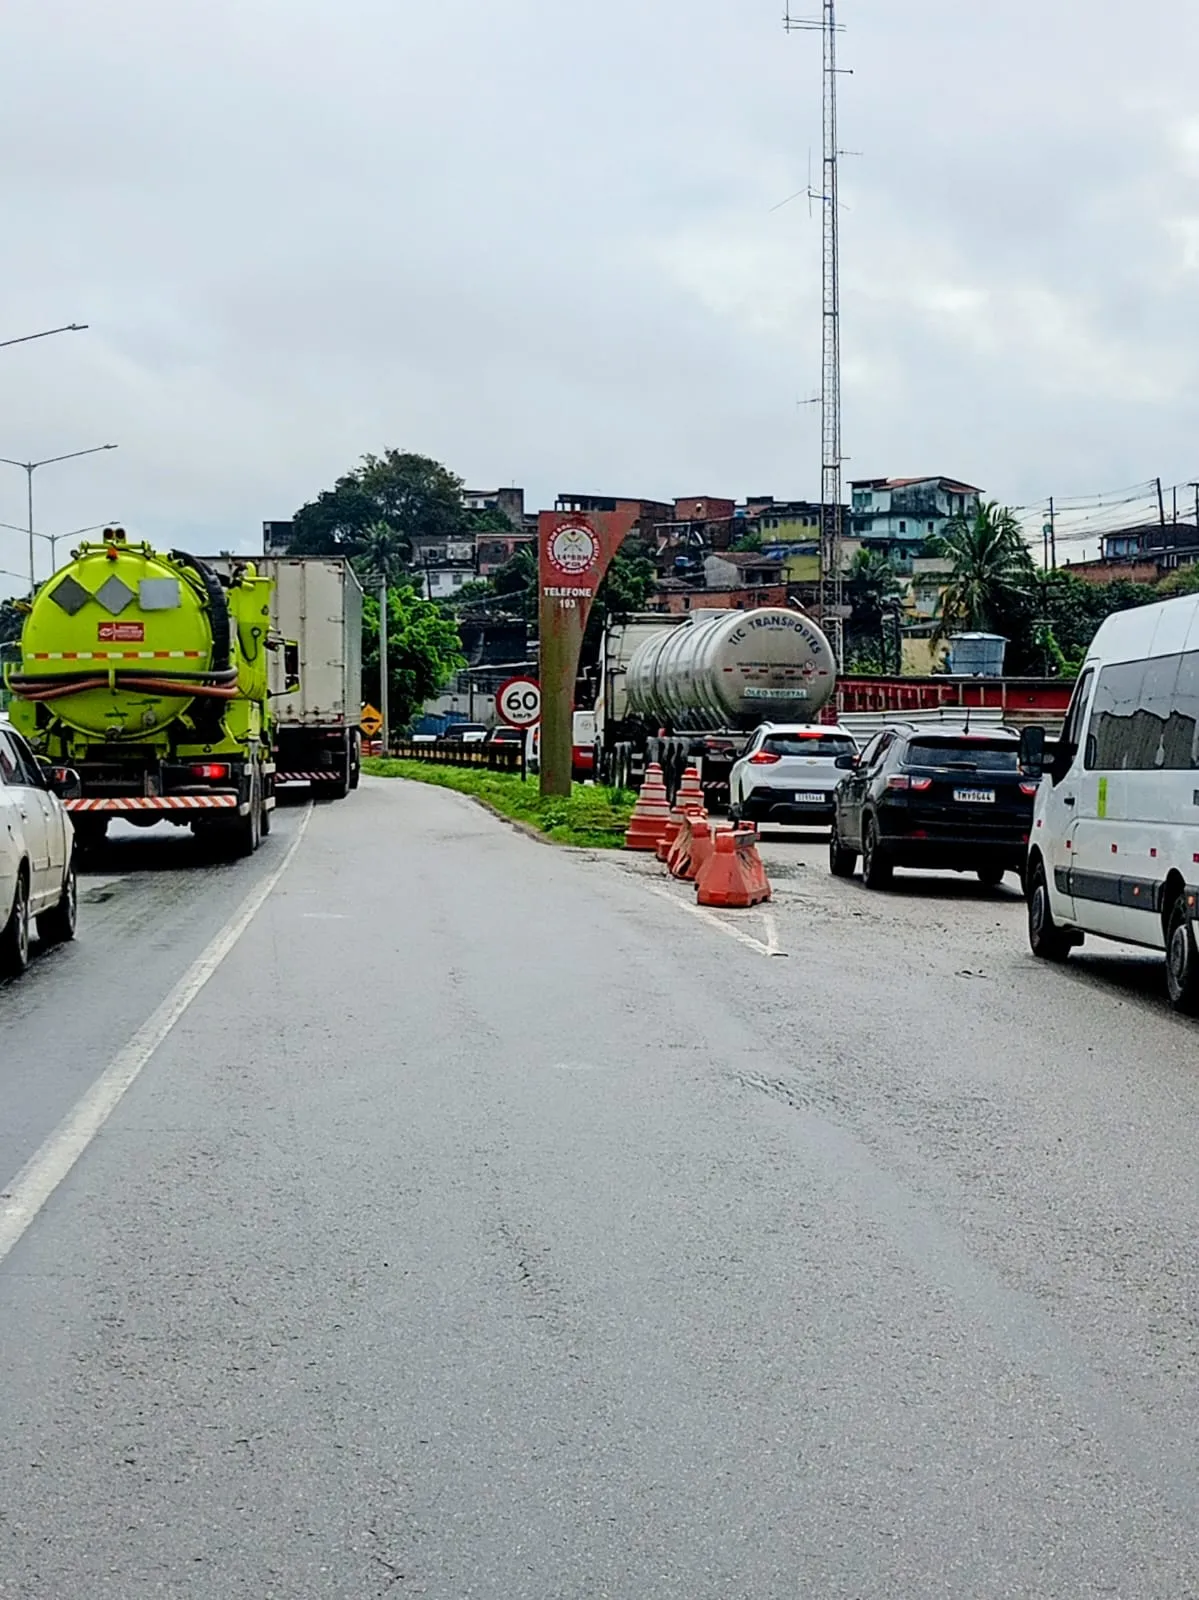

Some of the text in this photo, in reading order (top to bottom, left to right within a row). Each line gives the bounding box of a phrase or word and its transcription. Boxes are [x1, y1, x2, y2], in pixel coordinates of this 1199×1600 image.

[543, 587, 592, 597] TELEFONE
[559, 599, 576, 609] 193
[728, 616, 822, 654] TIC TRANSPORTES
[506, 691, 538, 711] 60
